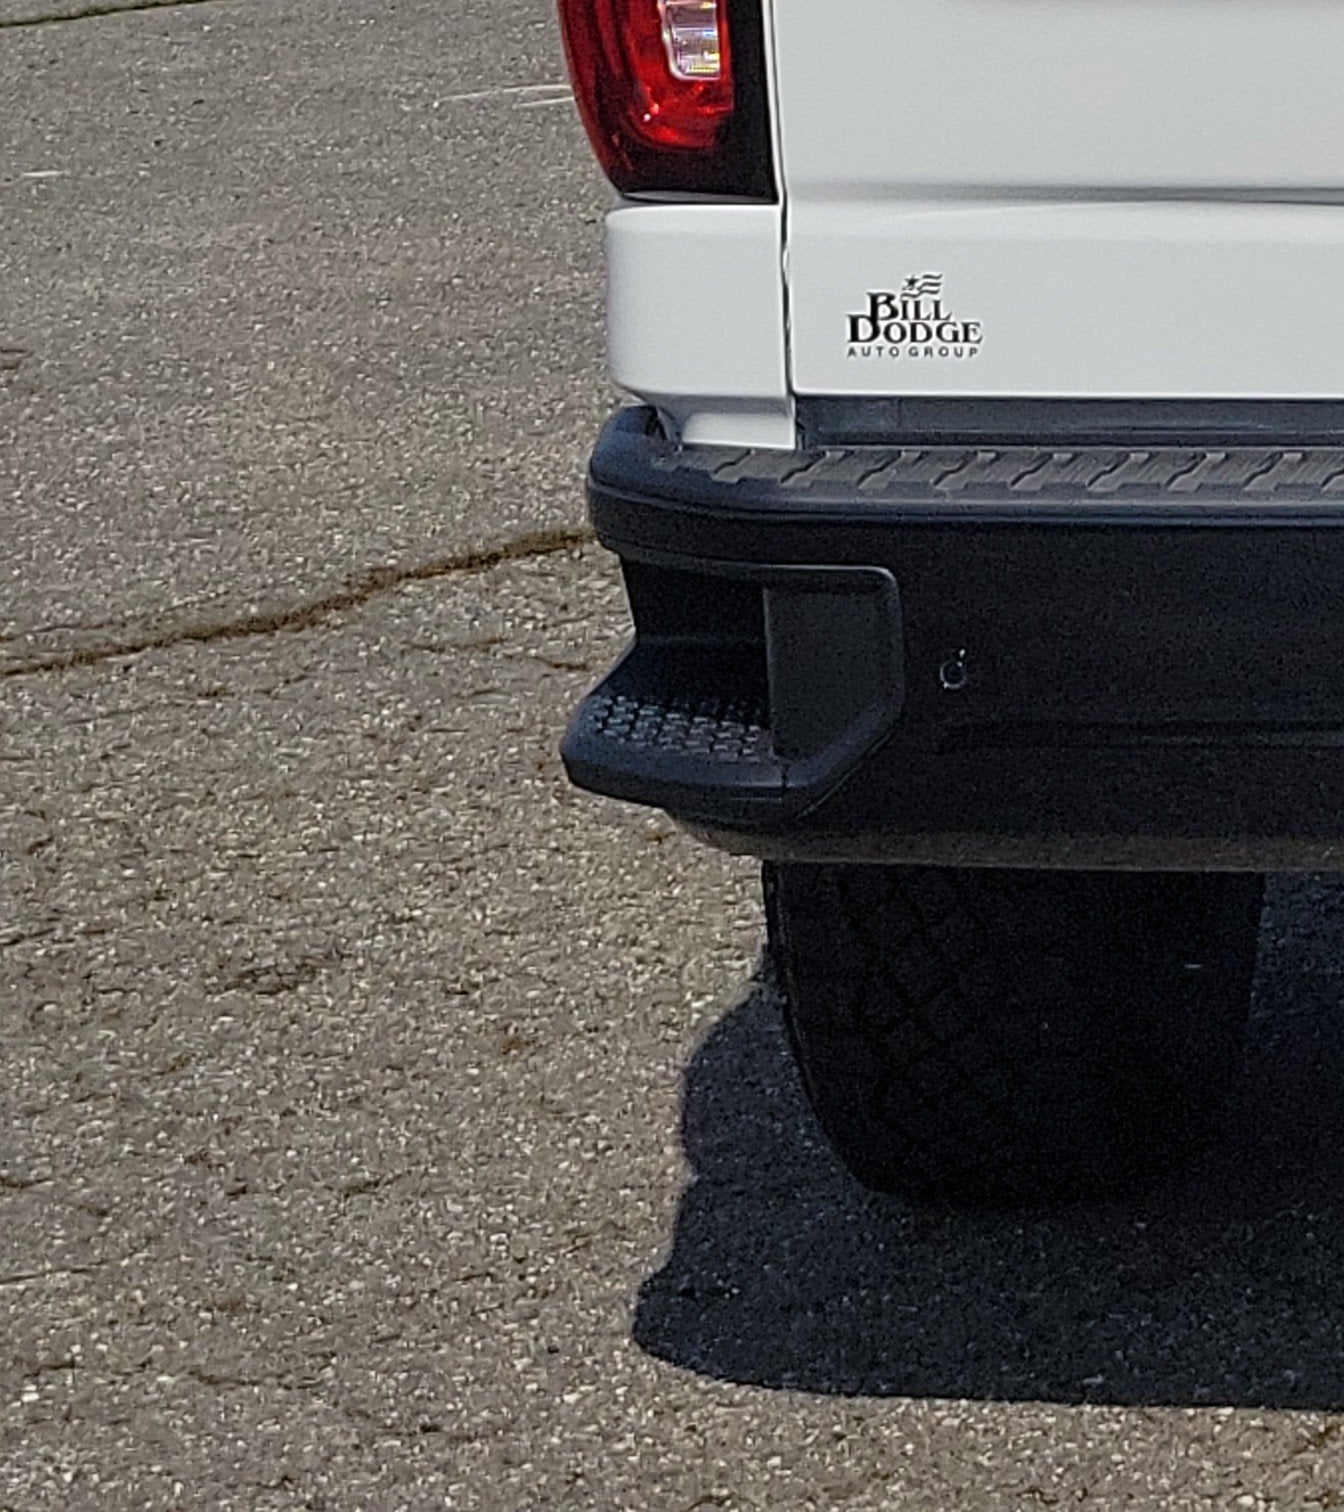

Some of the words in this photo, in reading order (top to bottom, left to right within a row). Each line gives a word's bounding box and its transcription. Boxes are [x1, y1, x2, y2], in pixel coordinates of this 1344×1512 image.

[867, 292, 952, 321] BILL
[847, 314, 983, 344] DODGE
[847, 346, 900, 357] AUTO
[908, 346, 978, 357] GROUP
